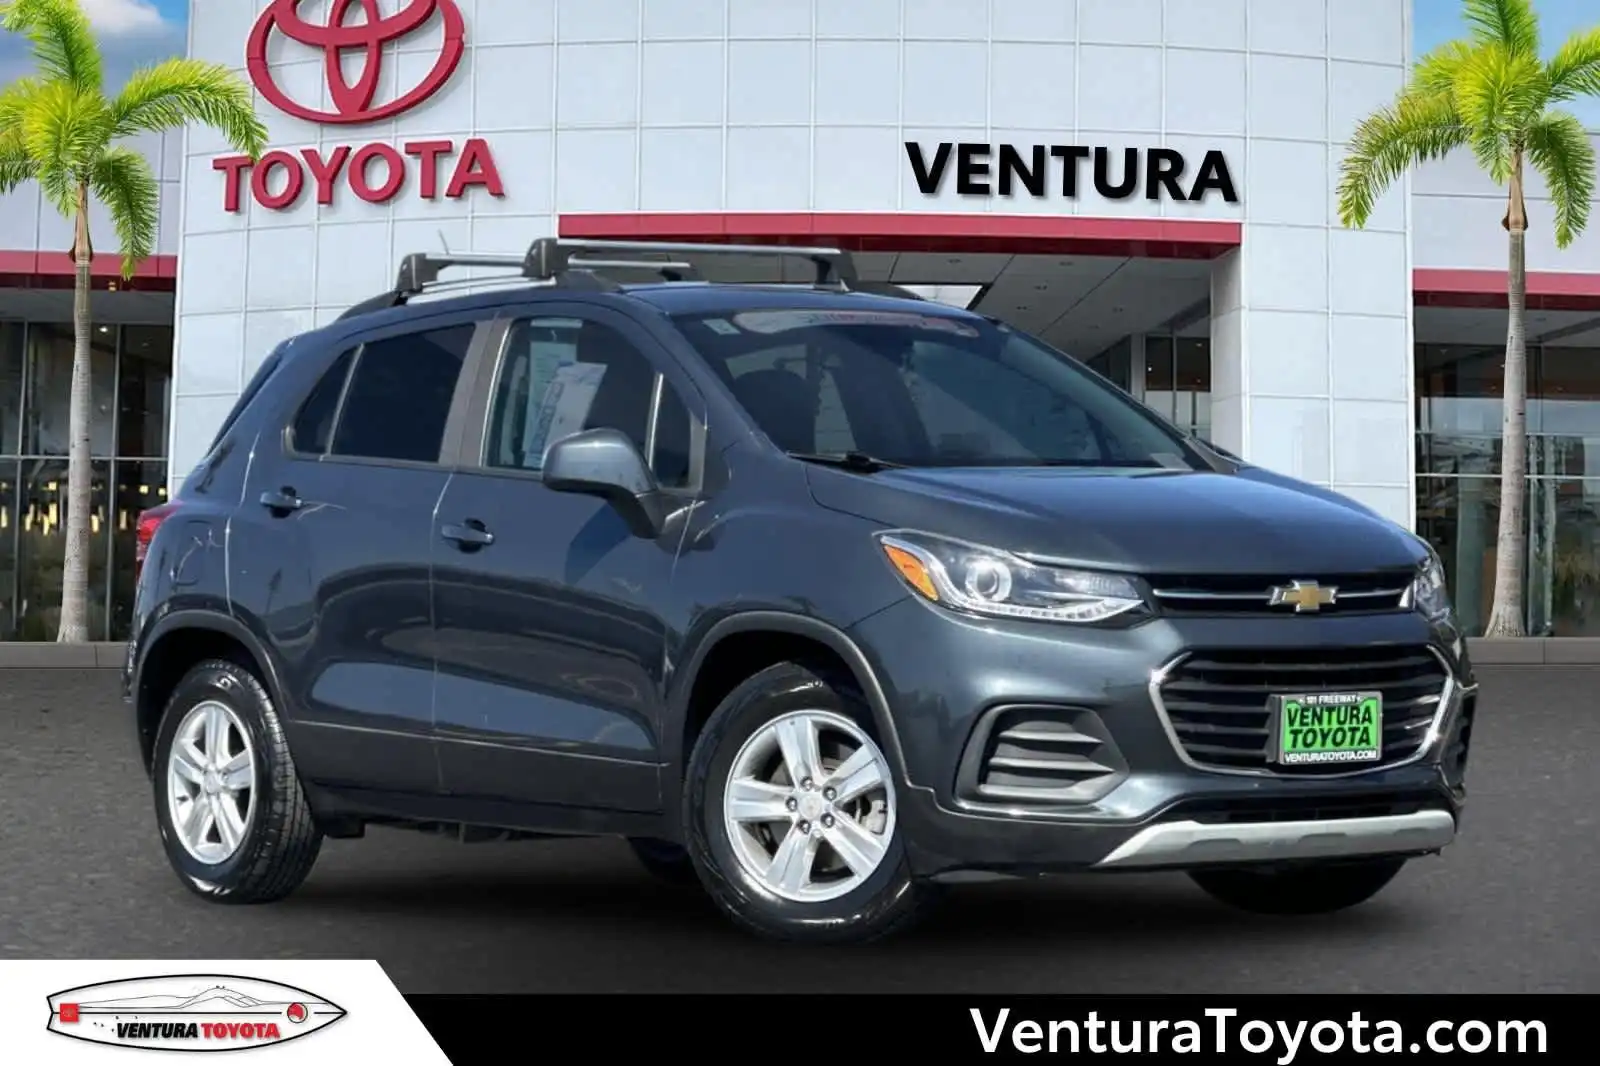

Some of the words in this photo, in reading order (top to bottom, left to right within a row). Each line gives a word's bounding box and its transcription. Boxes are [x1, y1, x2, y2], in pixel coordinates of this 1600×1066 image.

[212, 138, 505, 213] TOYOTA
[905, 142, 1238, 203] VENTURA
[1318, 694, 1356, 704] FREEWAY
[1288, 706, 1372, 727] VENTURA
[1290, 727, 1370, 748] TOYOTA
[1285, 750, 1377, 763] VENTURATOYOTA.COM
